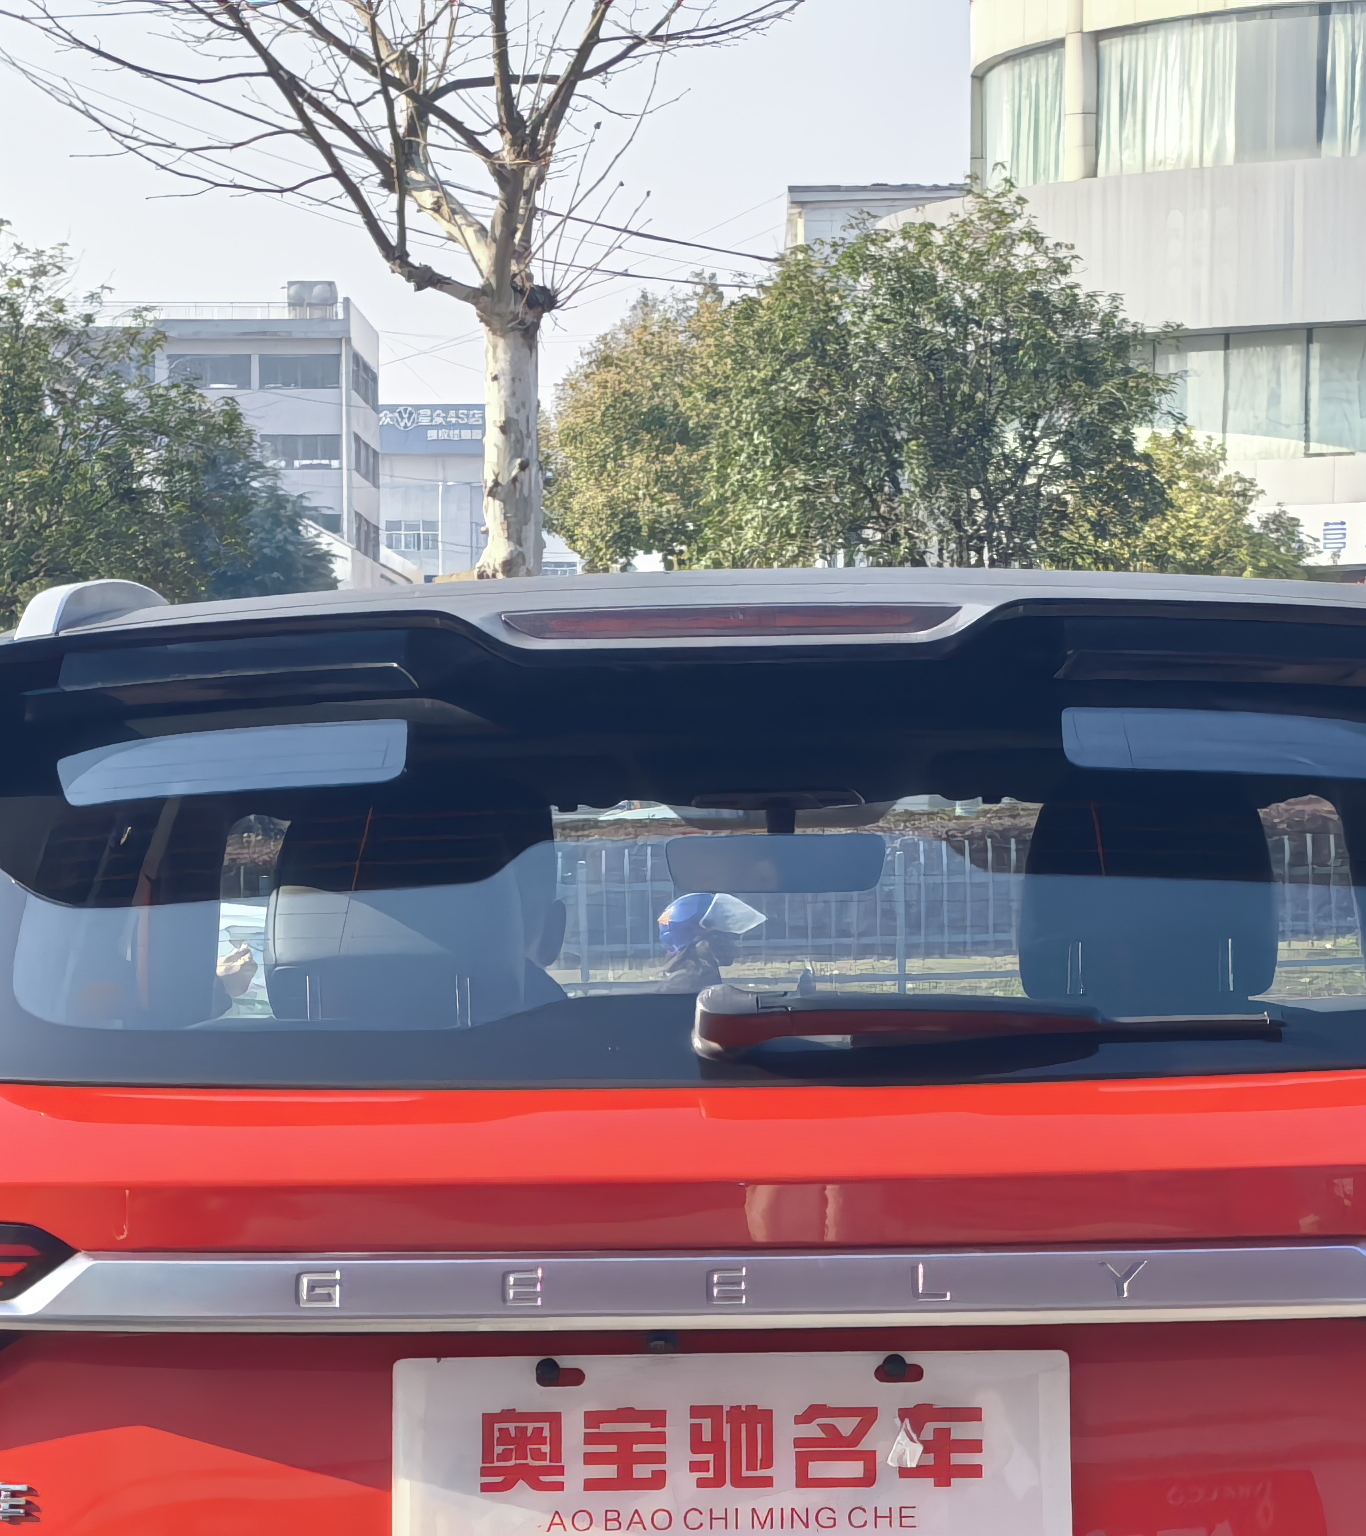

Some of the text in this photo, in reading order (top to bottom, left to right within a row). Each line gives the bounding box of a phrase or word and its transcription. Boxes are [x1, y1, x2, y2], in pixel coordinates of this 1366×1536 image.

[295, 1260, 1148, 1308] GEELY
[479, 1403, 984, 1493] 奥宝驰名车
[545, 1505, 918, 1533] AO BAO CHI MING CHE
